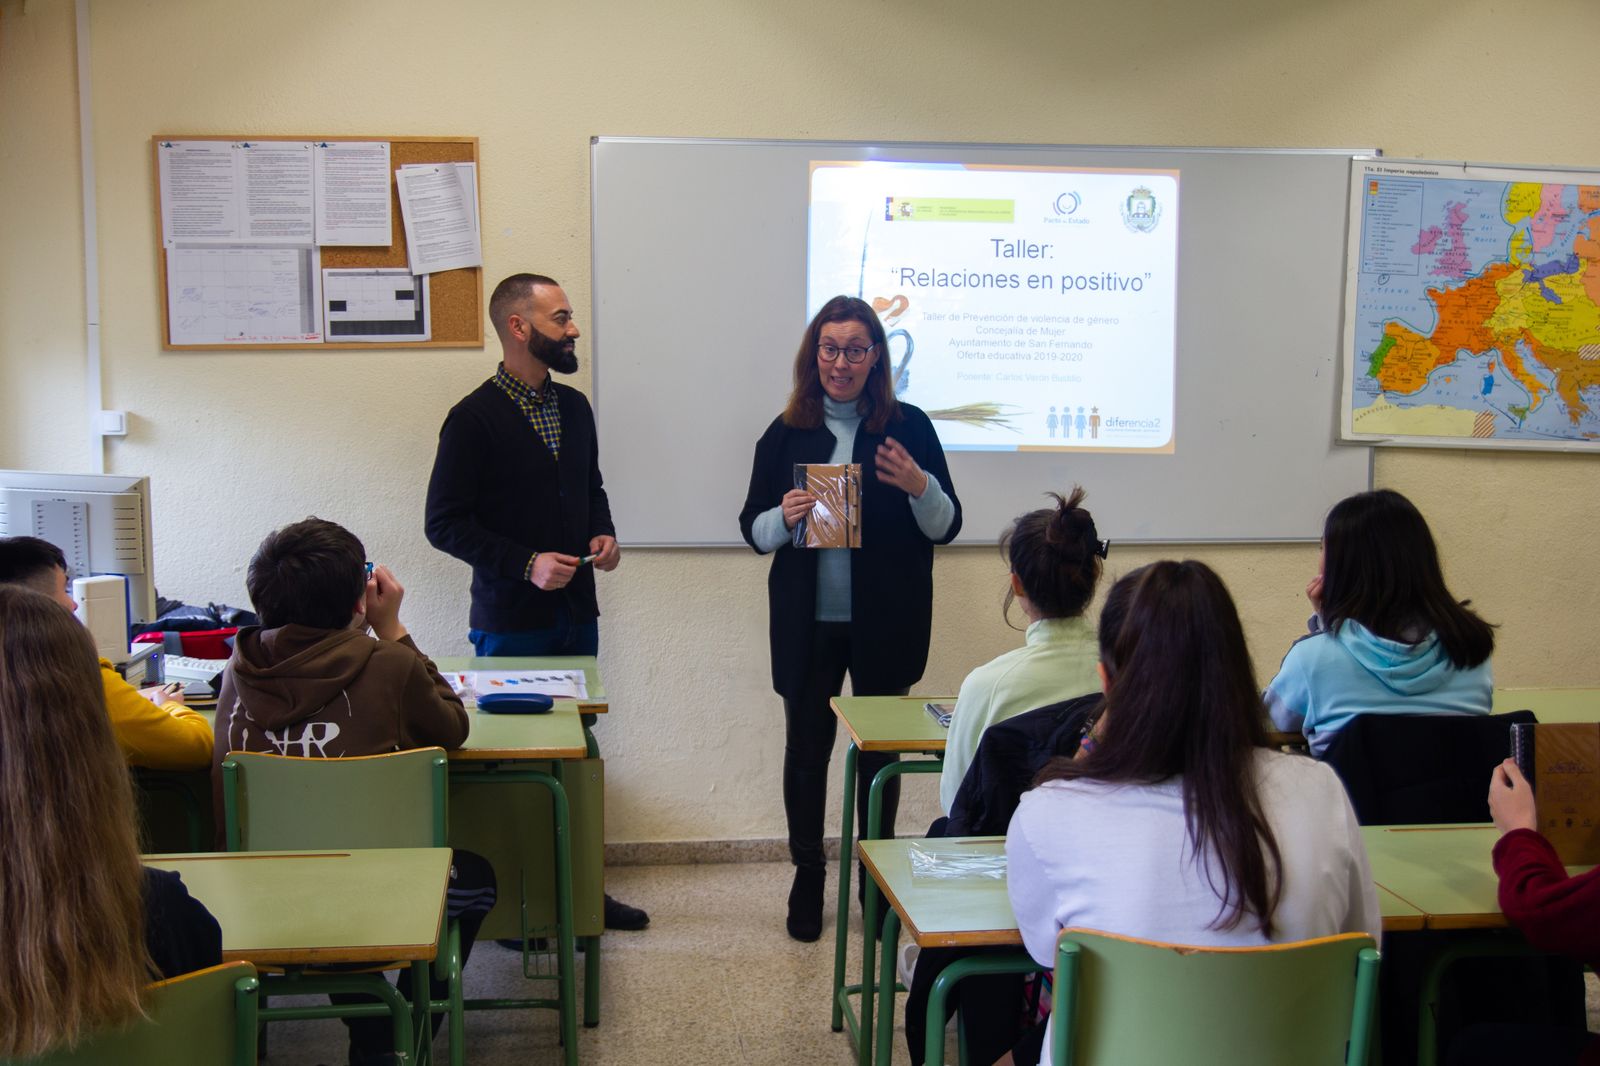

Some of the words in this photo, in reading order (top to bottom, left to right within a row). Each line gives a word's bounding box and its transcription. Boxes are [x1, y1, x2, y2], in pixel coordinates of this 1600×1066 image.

[991, 238, 1054, 259] Taller:
[891, 267, 1020, 288] “Relaciones
[1027, 273, 1054, 290] en
[1061, 272, 1152, 295] positivo”
[922, 311, 946, 322] Taller
[949, 311, 960, 322] de
[962, 312, 1014, 323] Prevención
[1017, 313, 1028, 323] de
[1030, 313, 1071, 324] violencia
[1072, 314, 1085, 325] de
[1087, 314, 1119, 328] género
[1026, 325, 1038, 336] de
[1040, 326, 1066, 338] Mujer
[949, 337, 1012, 349] Ayuntamiento
[1014, 338, 1026, 348] de
[1028, 338, 1047, 349] San
[1049, 339, 1093, 350] Fernando
[956, 351, 986, 361] Oferta
[987, 351, 1032, 361] educativa
[1033, 351, 1083, 362] 2019-2020
